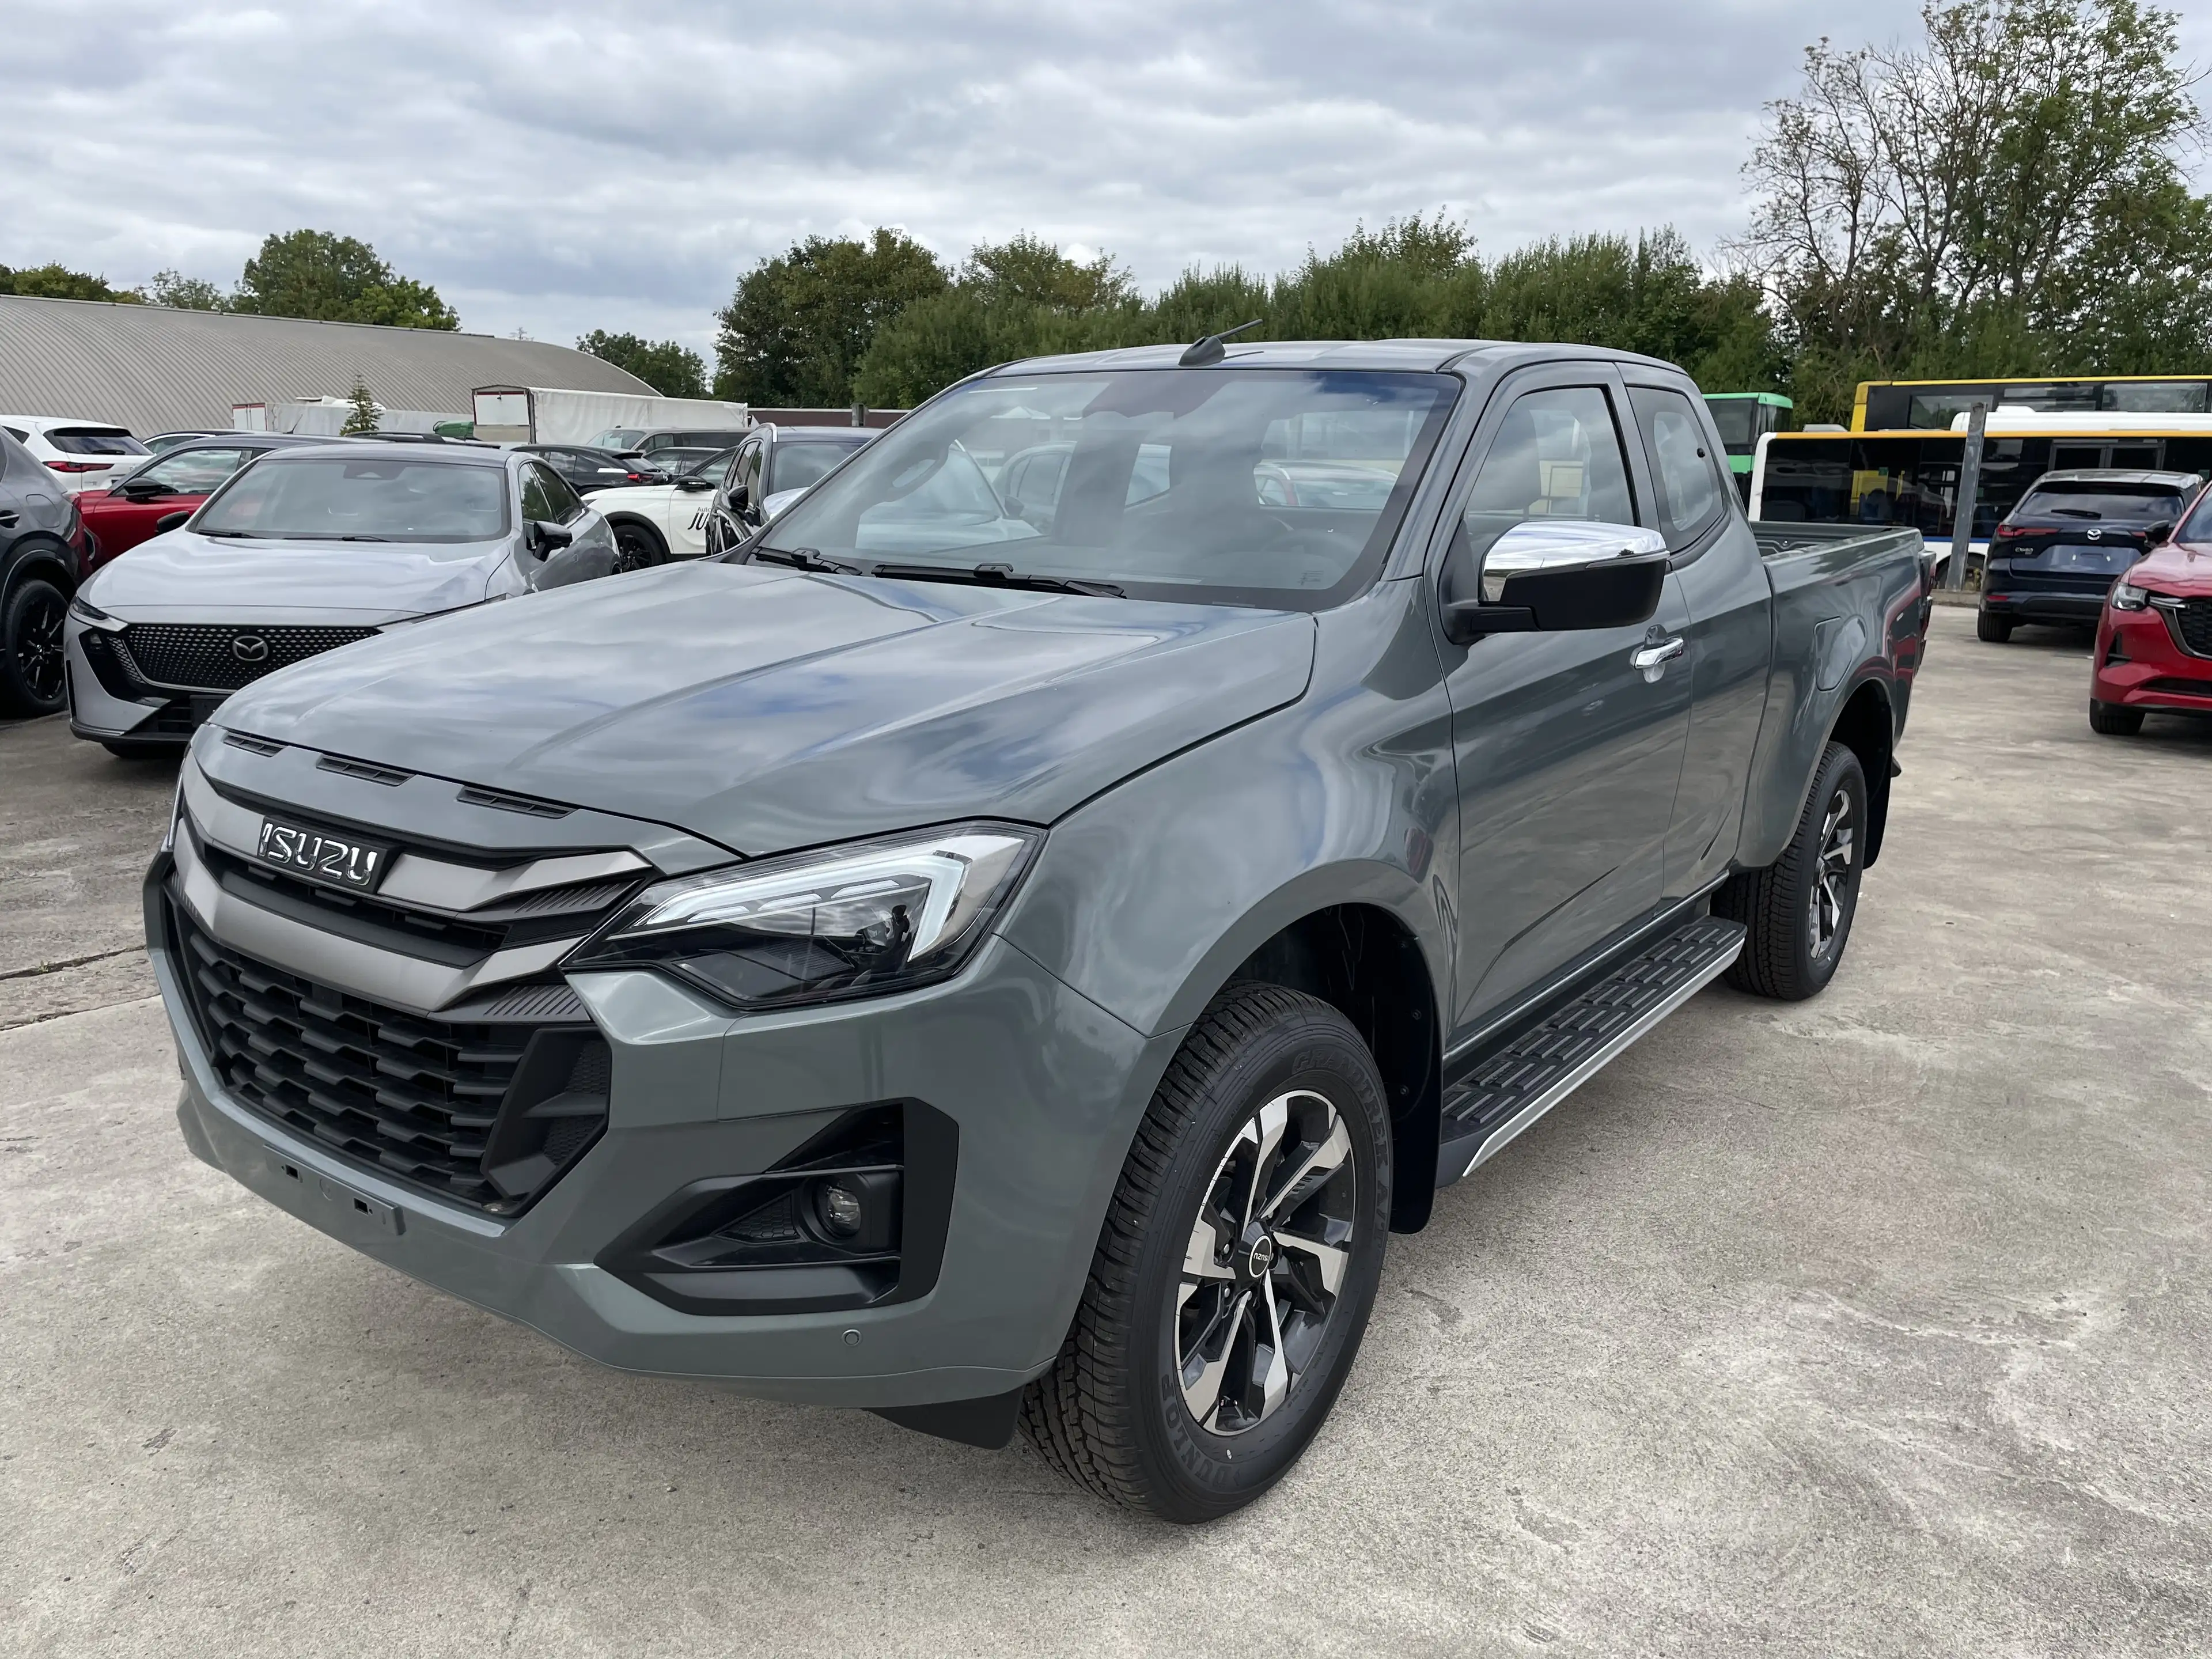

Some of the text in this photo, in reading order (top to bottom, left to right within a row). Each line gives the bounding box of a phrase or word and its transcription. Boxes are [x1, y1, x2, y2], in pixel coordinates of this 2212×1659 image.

[259, 823, 377, 886] ISUZU
[1291, 1048, 1388, 1169] GRANDTREK
[1253, 1252, 1269, 1262] ISUZU
[1161, 1374, 1232, 1488] DUNLOP
